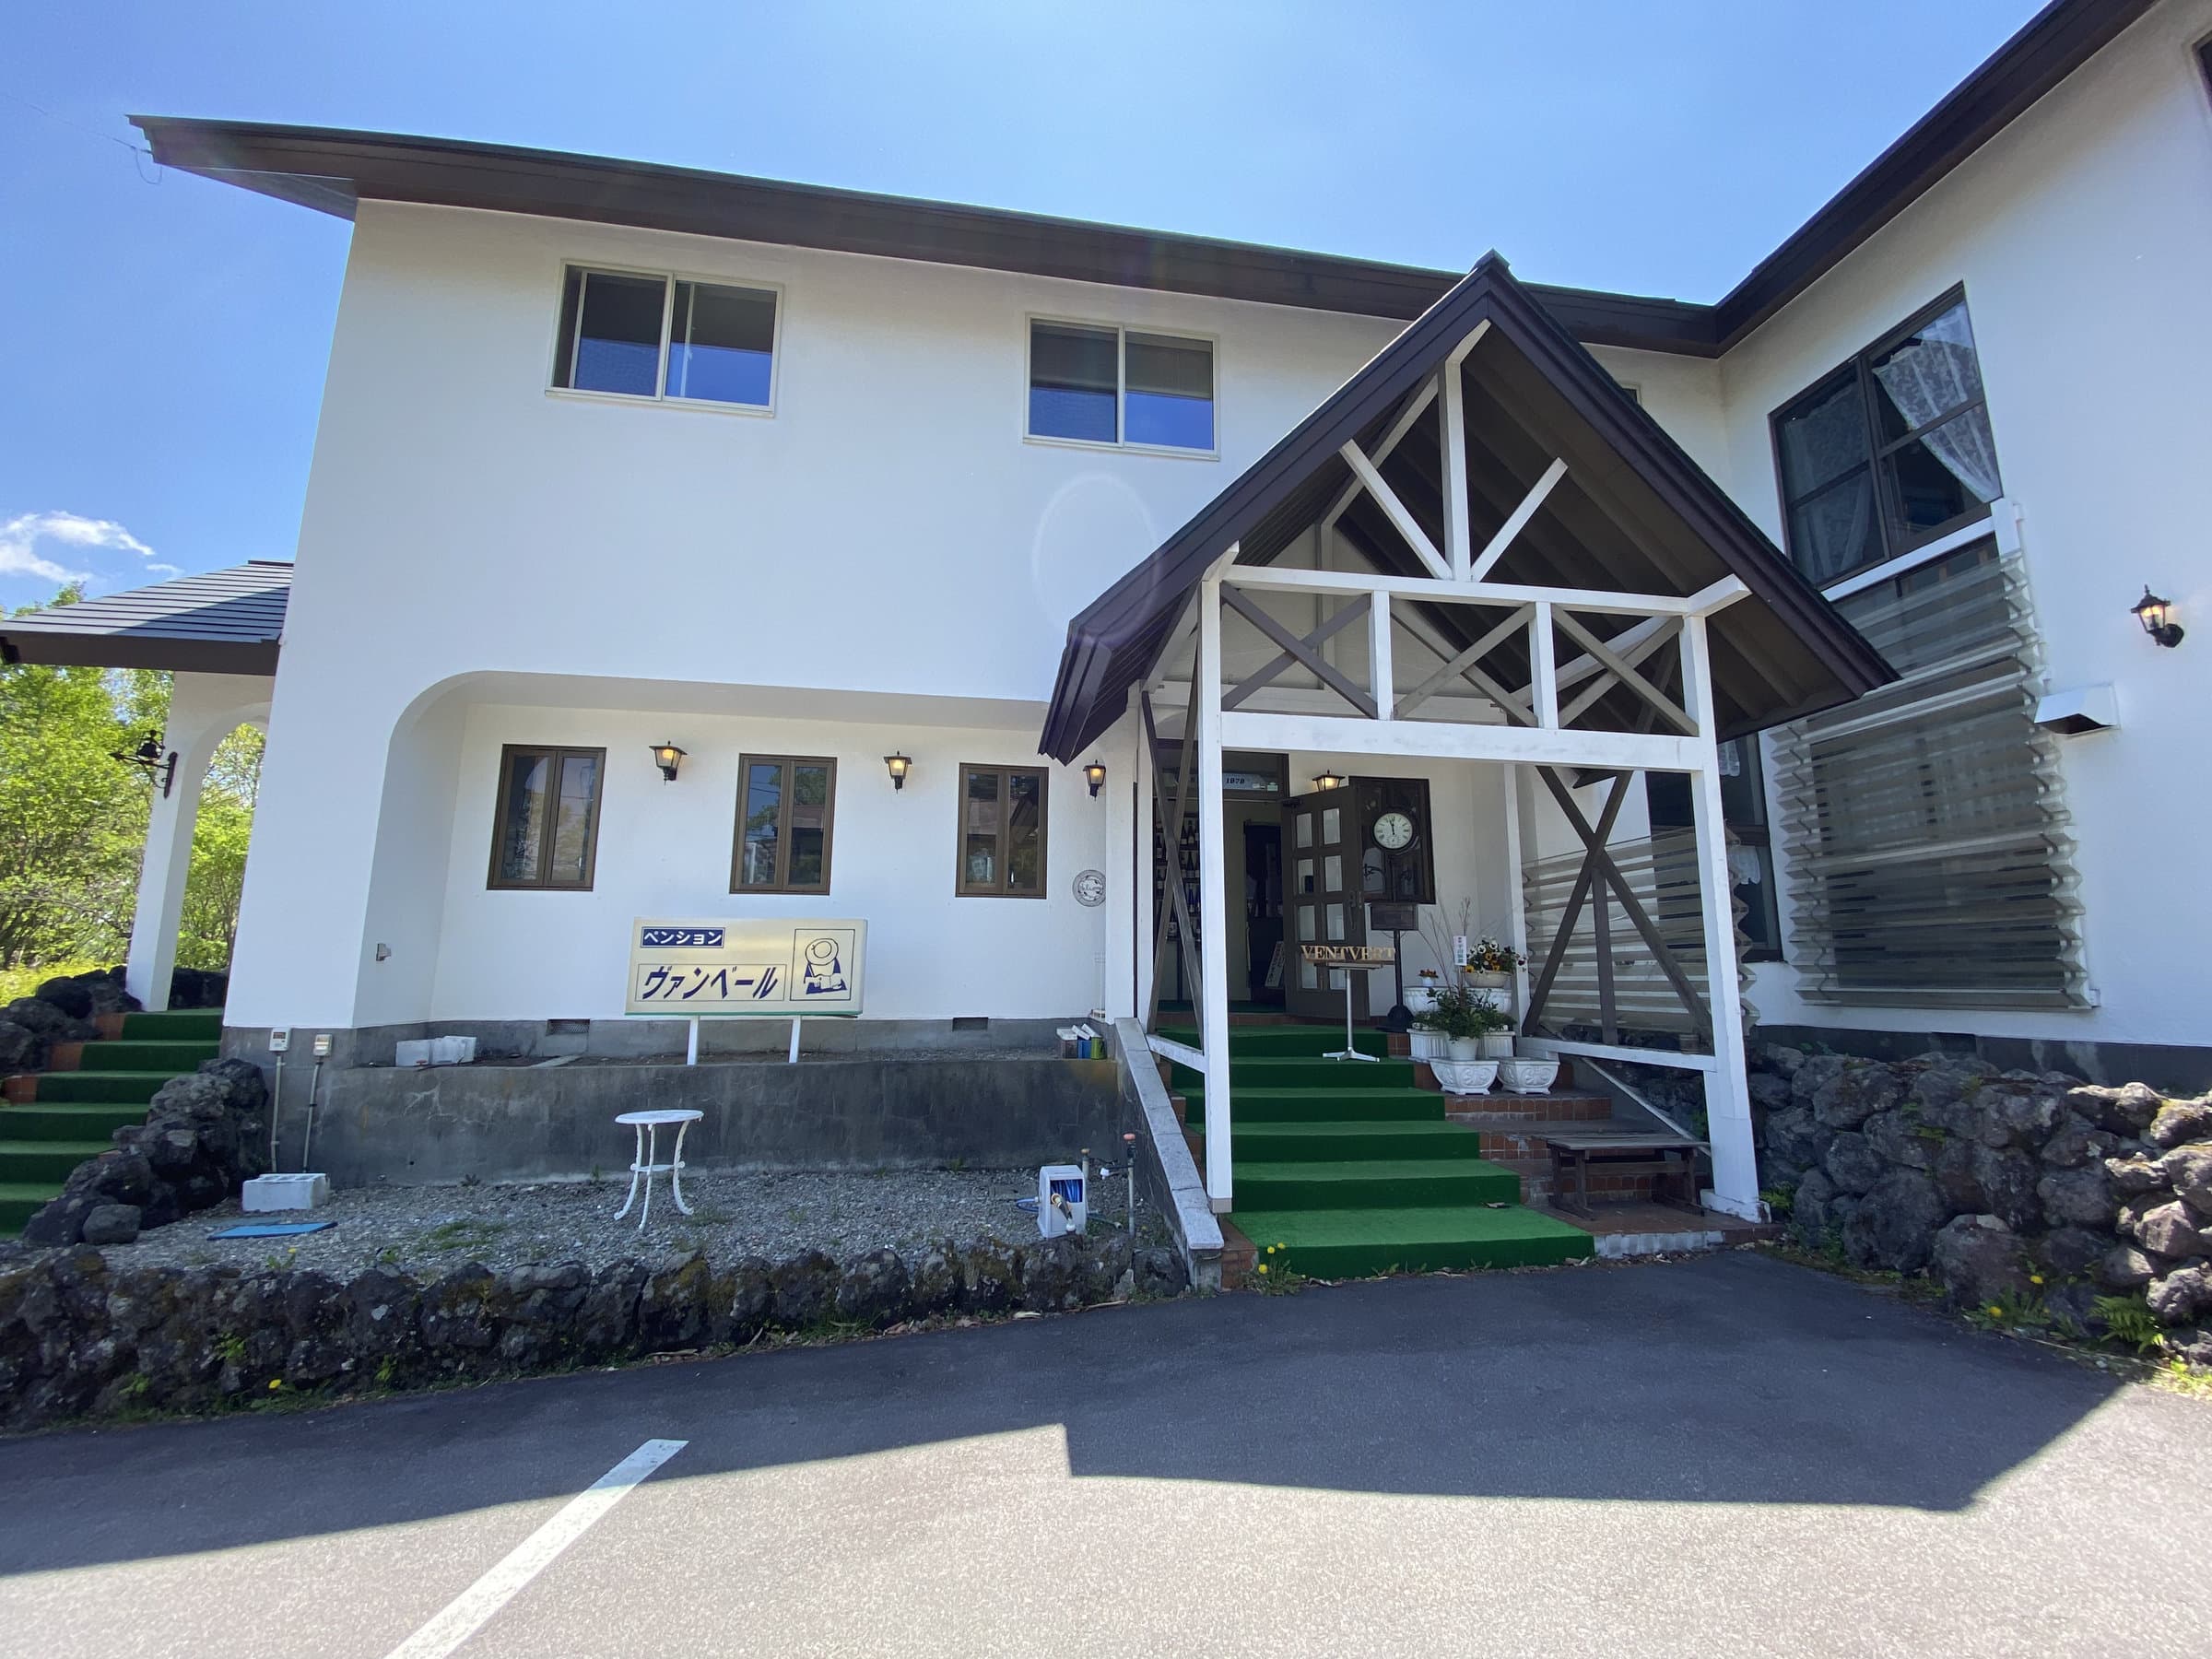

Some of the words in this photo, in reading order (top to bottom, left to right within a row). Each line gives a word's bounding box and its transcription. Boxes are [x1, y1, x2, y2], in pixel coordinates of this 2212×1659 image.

[644, 930, 723, 945] ペンション
[642, 965, 779, 1000] ヴァンベール
